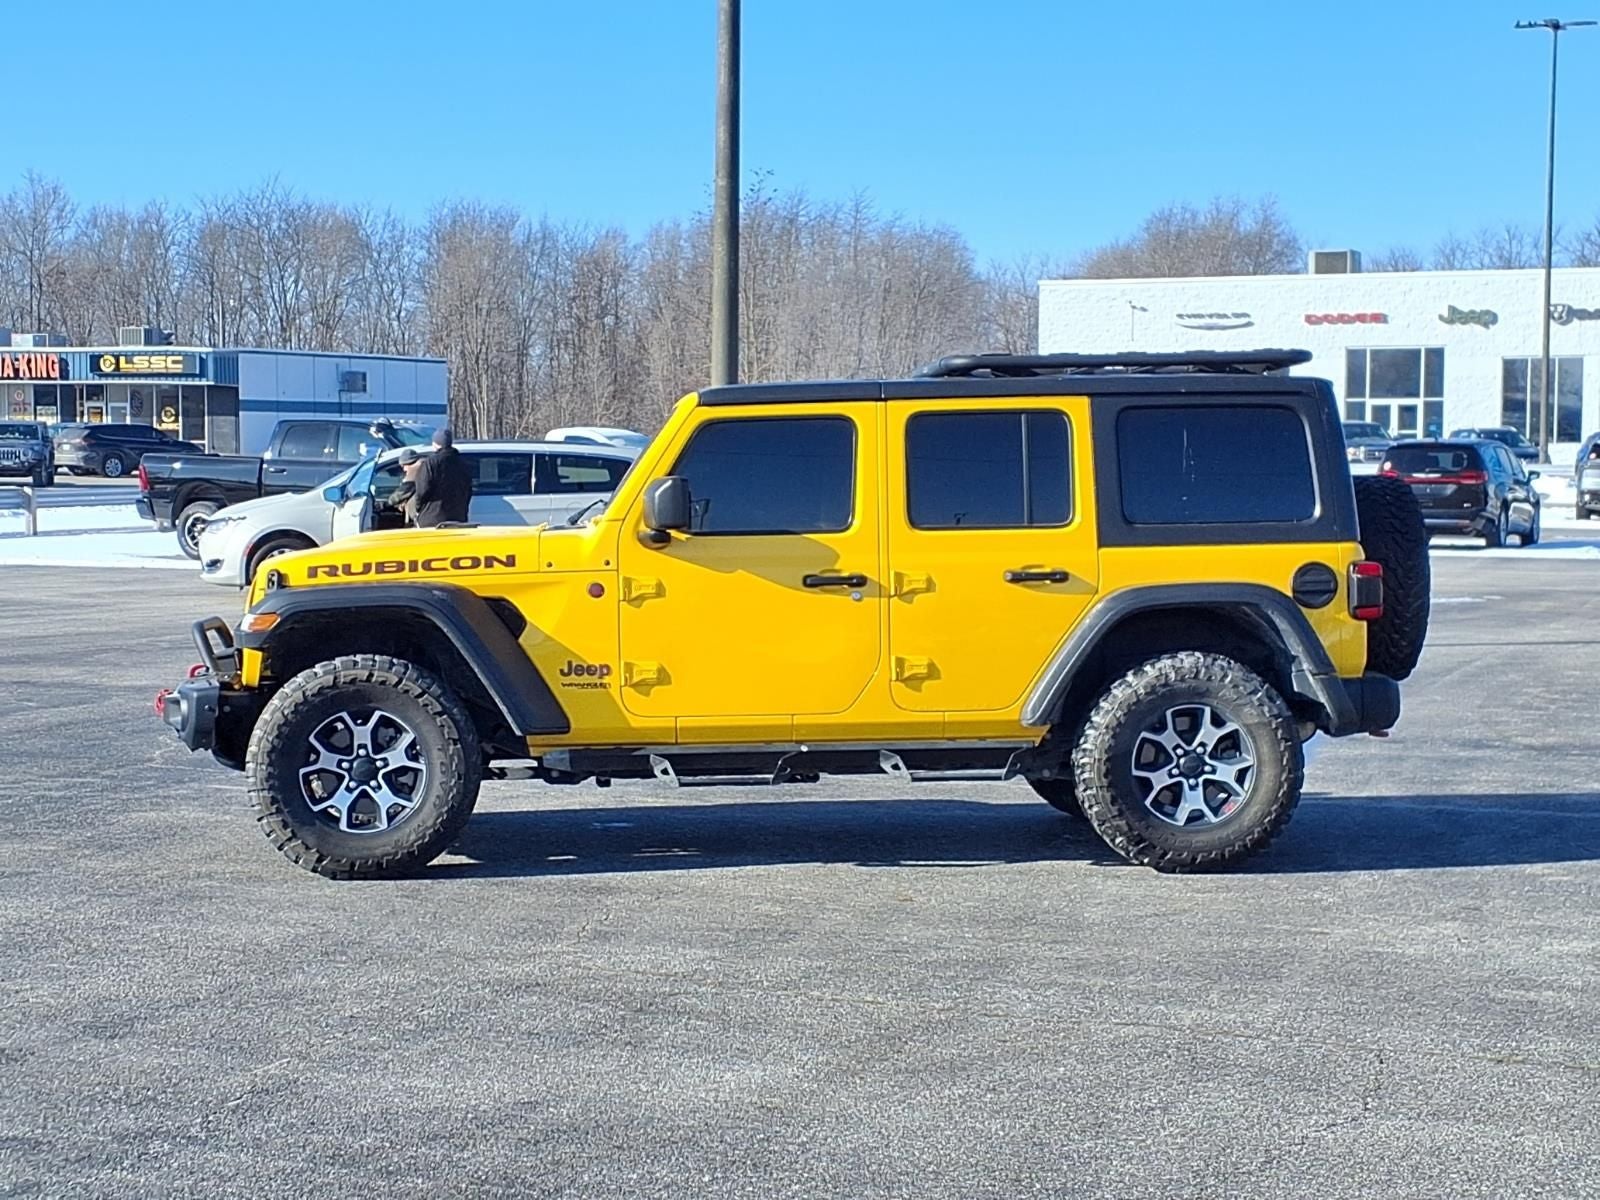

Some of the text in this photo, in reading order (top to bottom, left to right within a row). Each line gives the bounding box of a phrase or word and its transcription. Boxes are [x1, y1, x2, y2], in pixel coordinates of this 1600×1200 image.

[1438, 304, 1499, 330] Jeep
[0, 353, 58, 378] A-KING
[119, 355, 184, 369] LSSC
[307, 554, 516, 579] RUBICON
[559, 660, 612, 679] Jeep
